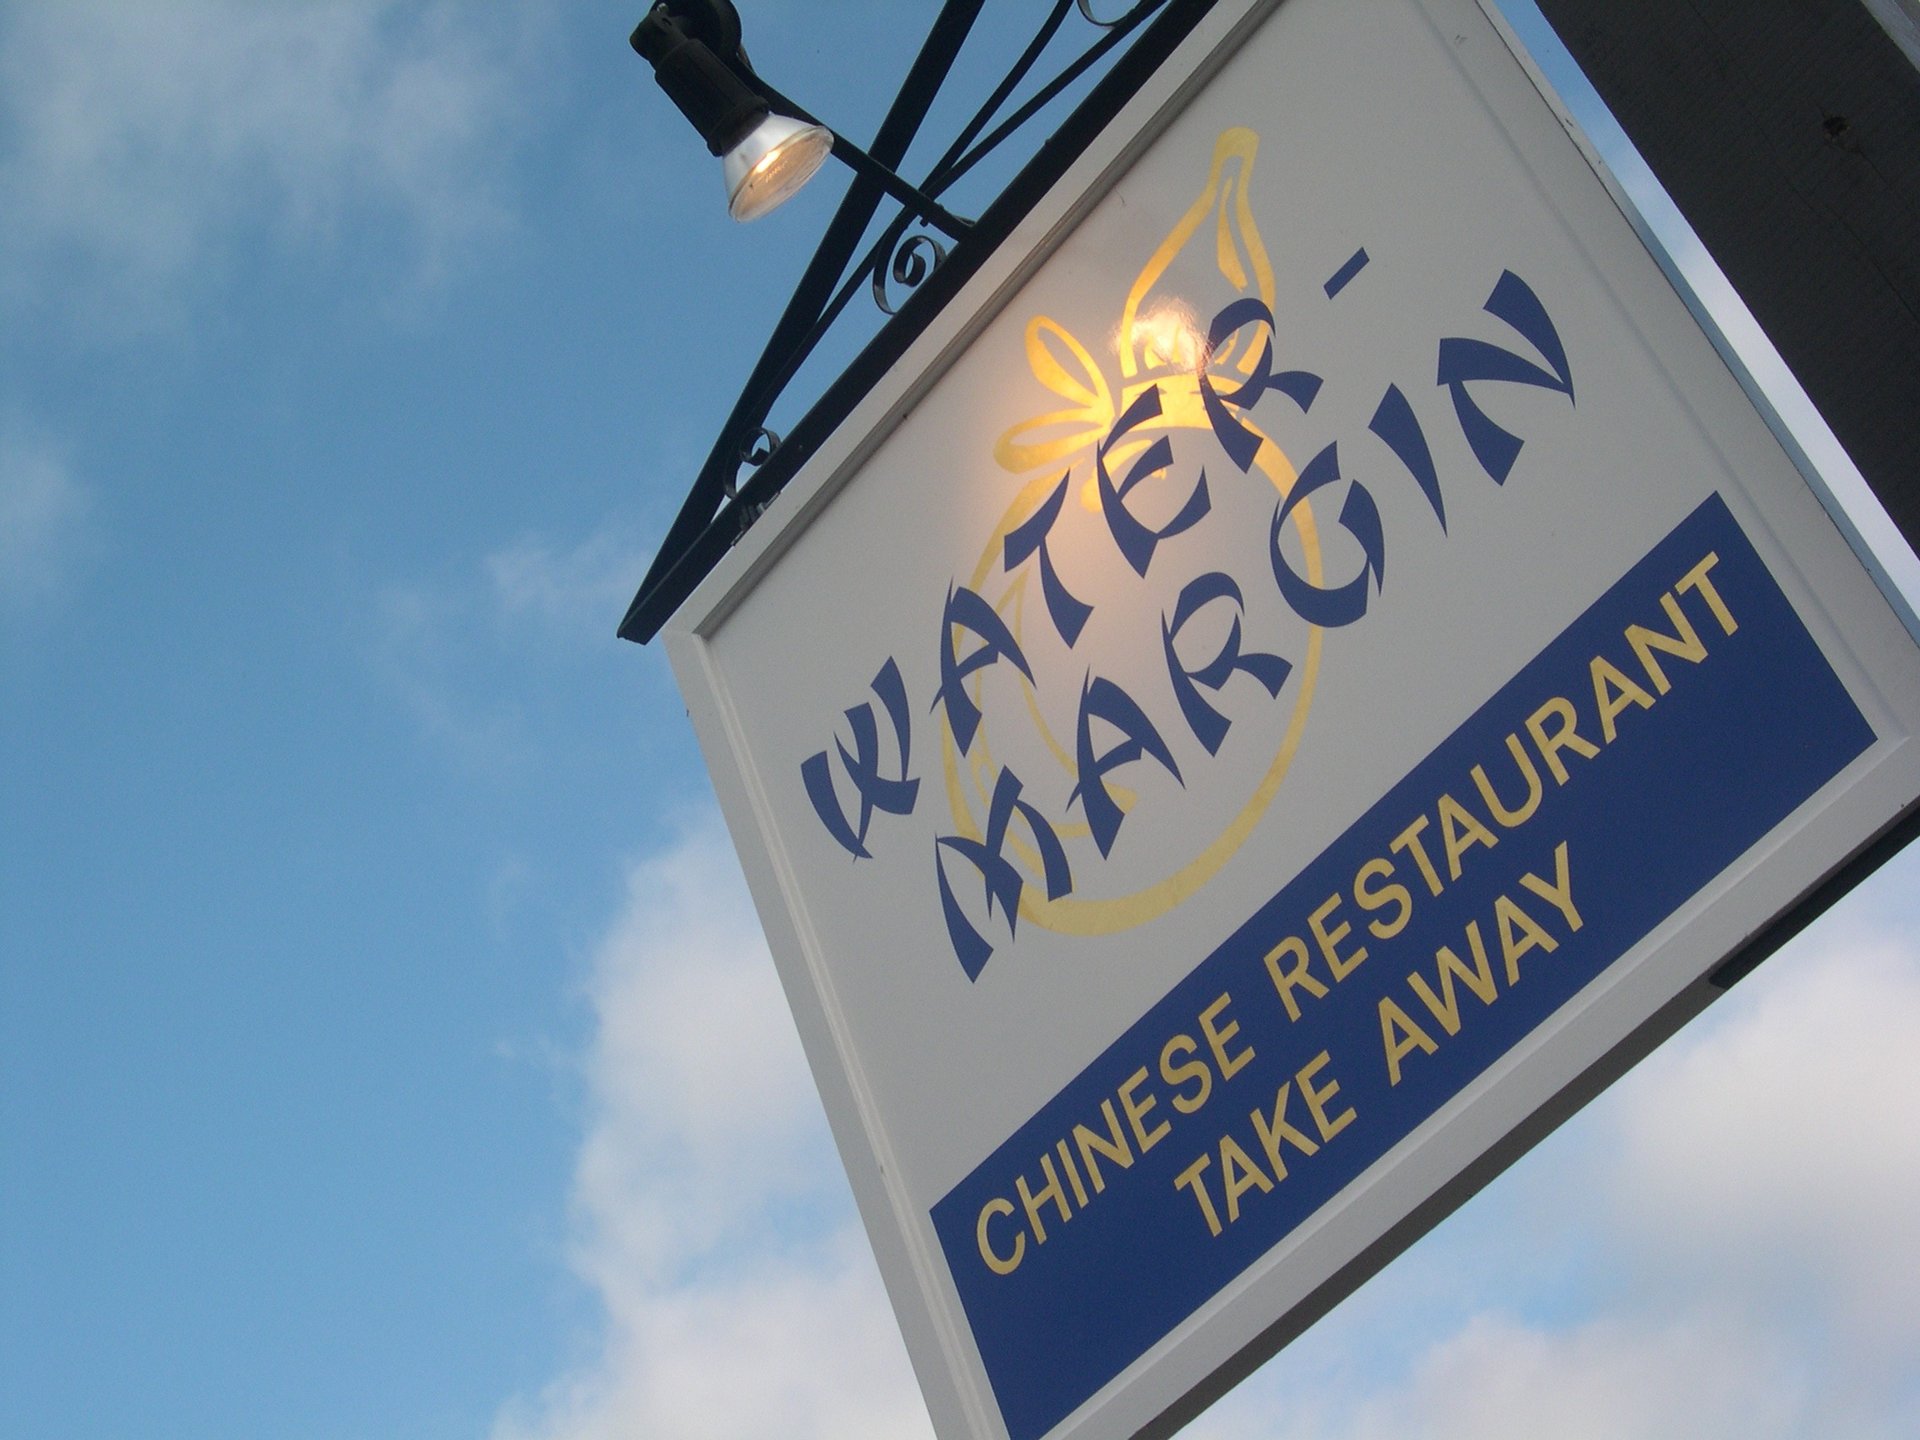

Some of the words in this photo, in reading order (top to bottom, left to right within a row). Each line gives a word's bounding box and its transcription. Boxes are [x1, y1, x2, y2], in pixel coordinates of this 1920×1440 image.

[935, 269, 1576, 984] MARGIN
[976, 992, 1255, 1276] CHINESE
[1263, 551, 1740, 1022] RESTAURANT
[1173, 1052, 1357, 1239] TAKE
[1377, 841, 1585, 1087] AWAY
